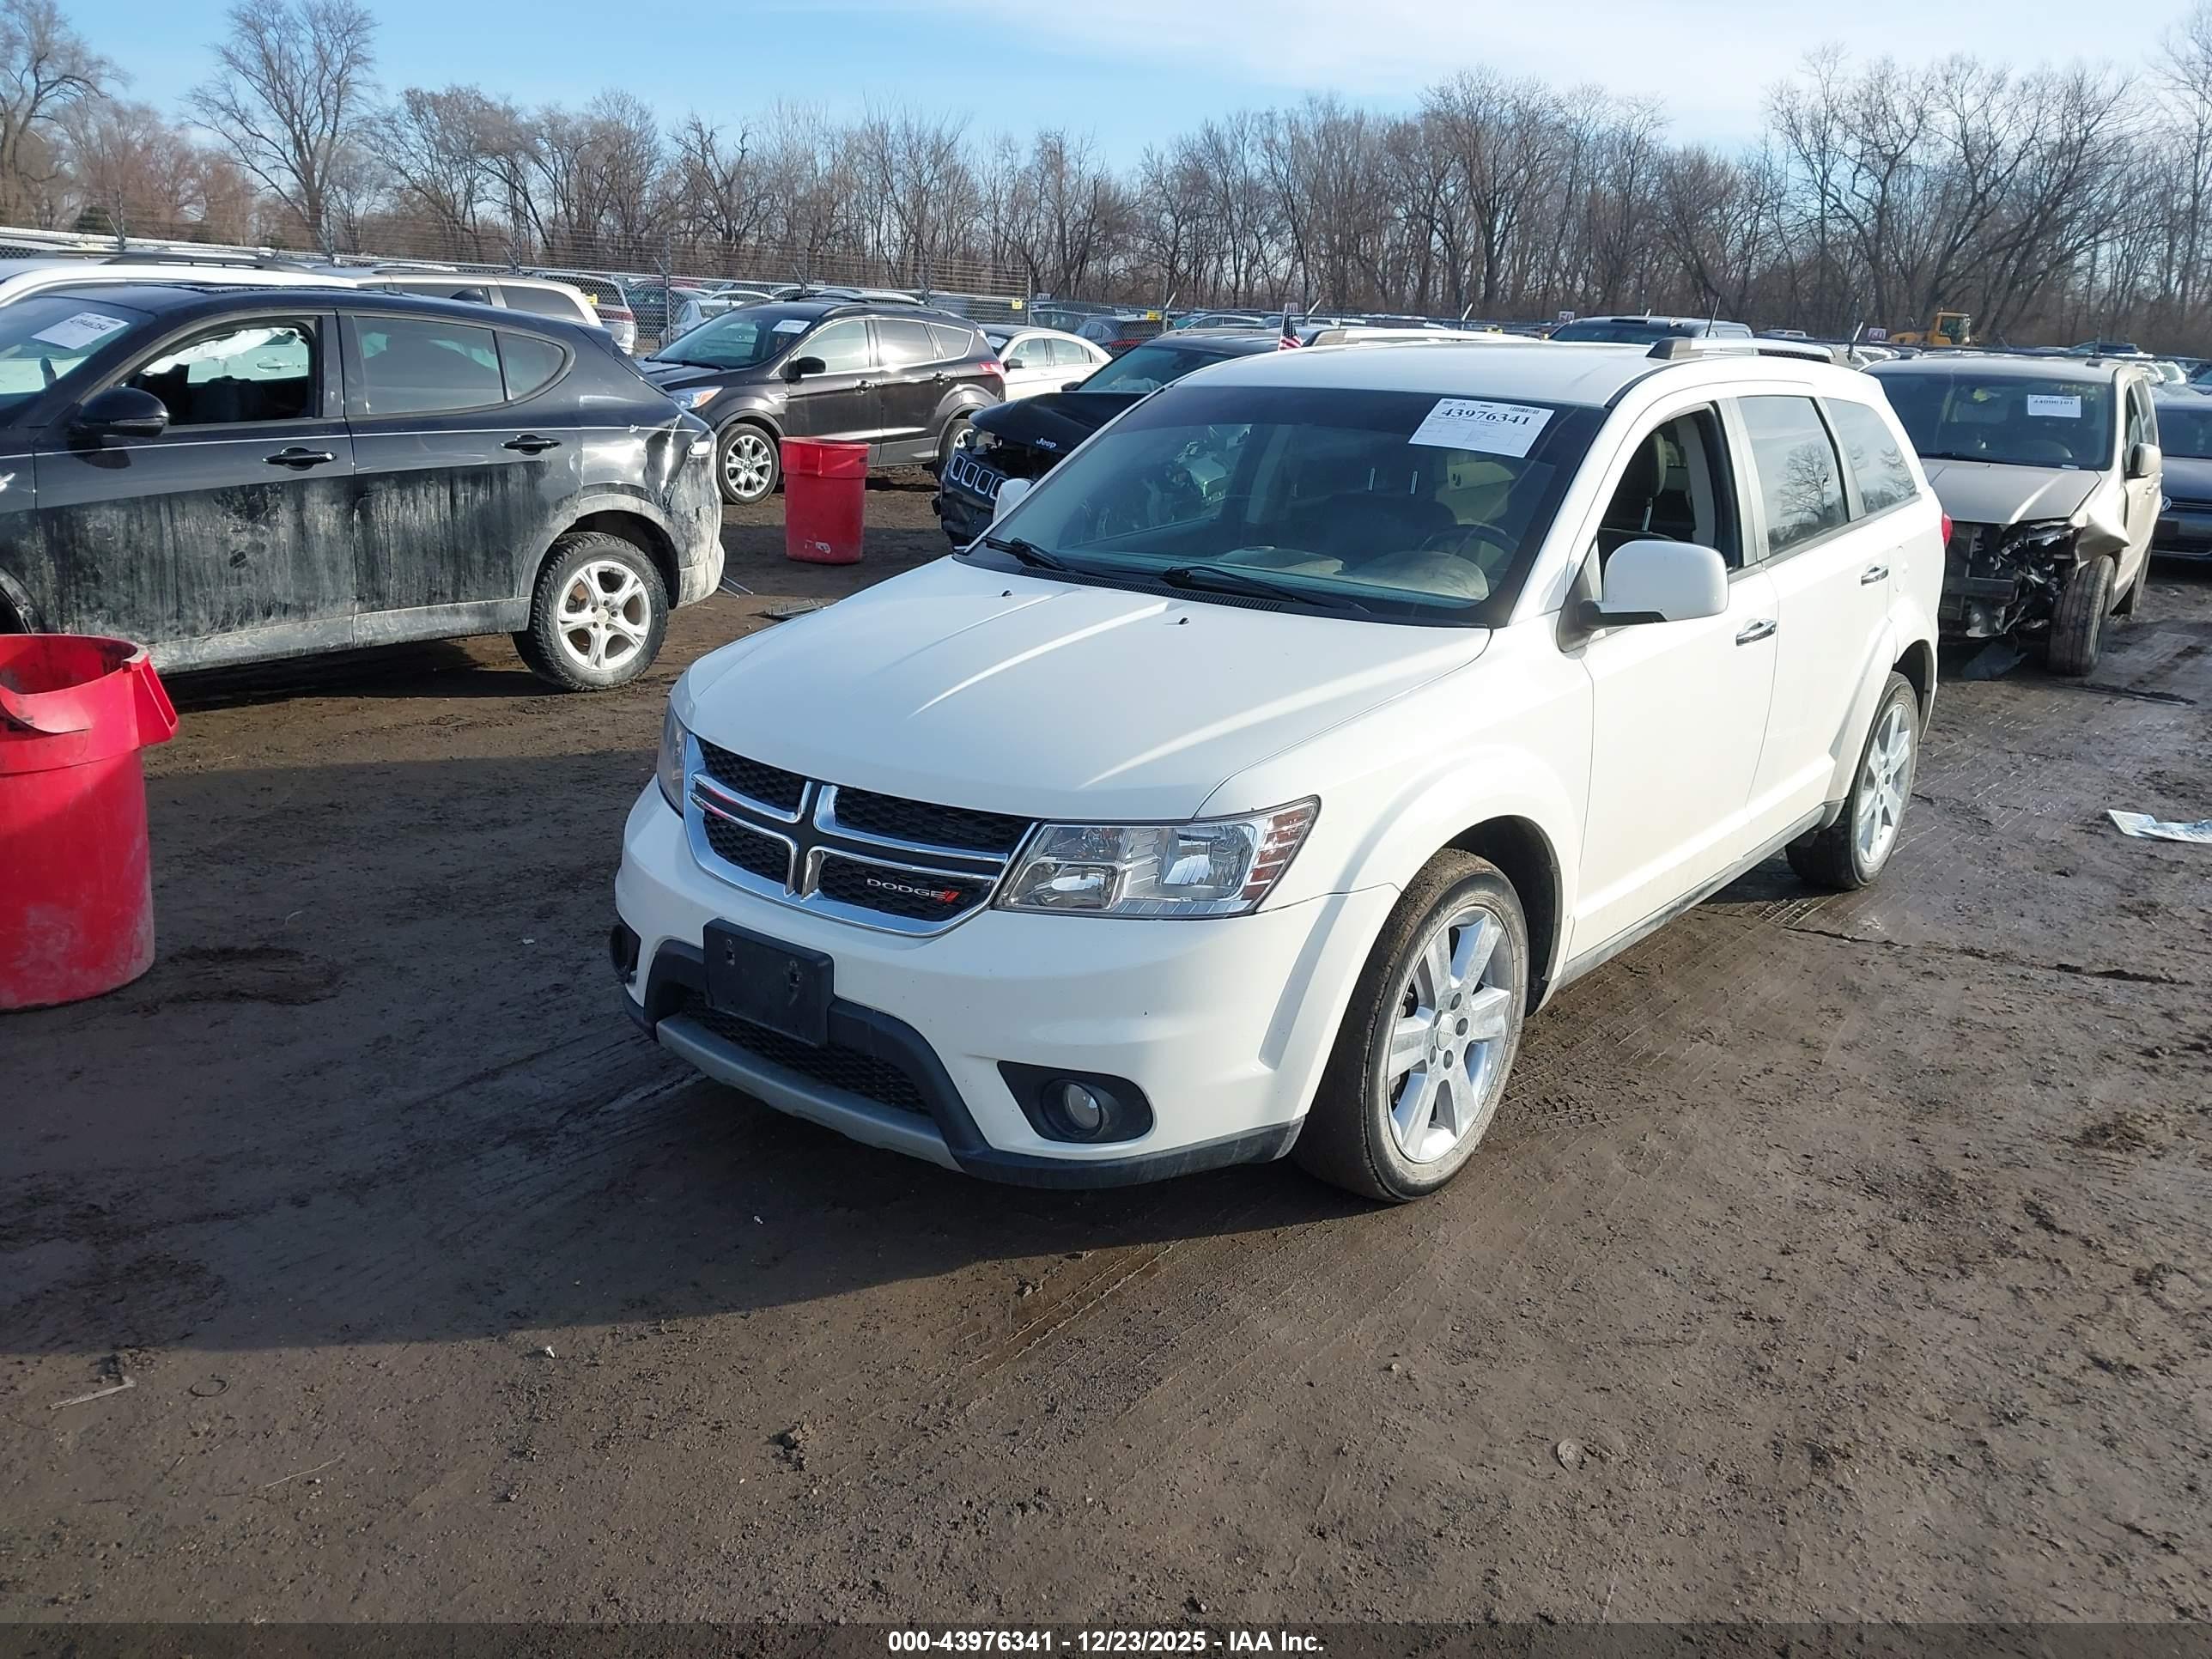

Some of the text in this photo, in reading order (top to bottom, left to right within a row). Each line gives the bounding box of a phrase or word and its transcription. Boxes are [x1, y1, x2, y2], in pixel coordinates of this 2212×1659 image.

[1442, 408, 1531, 426] 43976341
[1036, 438, 1057, 448] Jeep
[866, 878, 946, 900] DODGE
